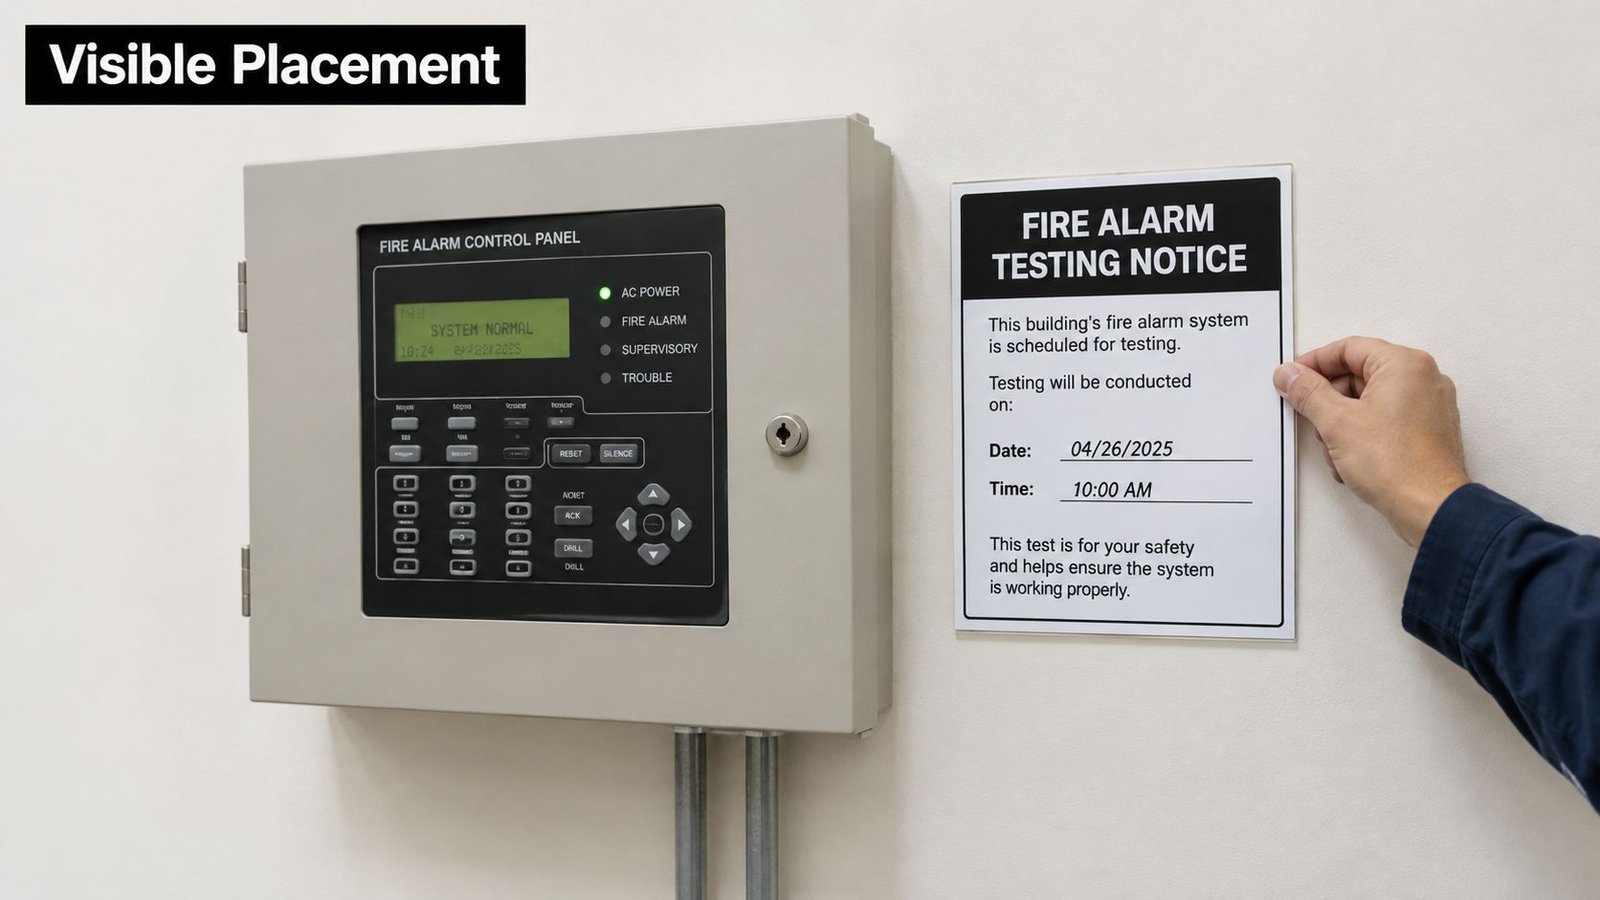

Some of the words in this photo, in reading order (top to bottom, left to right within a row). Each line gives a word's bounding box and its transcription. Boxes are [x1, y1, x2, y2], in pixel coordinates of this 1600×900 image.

[1023, 210, 1089, 239] FIRE
[1098, 204, 1214, 236] ALARM
[380, 240, 409, 253] FIRE
[413, 237, 460, 251] ALARM
[465, 233, 531, 248] CONTROL
[536, 231, 580, 245] PANEL
[992, 249, 1120, 279] TESTING
[1131, 244, 1247, 275] NOTICE
[622, 287, 636, 298] AC
[640, 286, 679, 297] POWER
[431, 323, 478, 337] SYSTEM
[486, 322, 534, 335] NORMAL
[623, 316, 645, 326] FIRE
[649, 315, 686, 325] ALARM
[989, 317, 1020, 332] This
[1027, 316, 1100, 334] building's
[1106, 315, 1132, 329] fire
[1138, 314, 1183, 329] alarm
[1190, 314, 1248, 331] system
[622, 344, 698, 355] SUPERVISORY
[990, 339, 1001, 353] is
[1007, 337, 1087, 353] scheduled
[1093, 337, 1115, 351] for
[1121, 336, 1180, 354] testing.
[622, 372, 672, 383] TROUBLE
[989, 375, 1044, 393] Testing
[1050, 375, 1074, 389] will
[1081, 375, 1100, 389] be
[1106, 373, 1191, 389] conducted
[989, 401, 1012, 411] on:
[990, 443, 1031, 457] Date:
[1071, 440, 1173, 458] 04/26/2025
[989, 481, 1033, 495] Time:
[1075, 482, 1118, 497] 10:00
[1124, 482, 1152, 497] AM
[990, 537, 1021, 551] This
[1027, 538, 1055, 551] test
[1061, 538, 1073, 552] is
[1078, 538, 1100, 552] for
[1105, 542, 1139, 556] your
[1145, 539, 1194, 558] safety
[990, 560, 1017, 572] and
[1024, 560, 1063, 577] helps
[1069, 563, 1121, 575] ensure
[1127, 561, 1151, 575] the
[1157, 563, 1213, 580] system
[991, 580, 1001, 594] is
[1006, 580, 1062, 599] working
[1068, 582, 1129, 600] properly.
